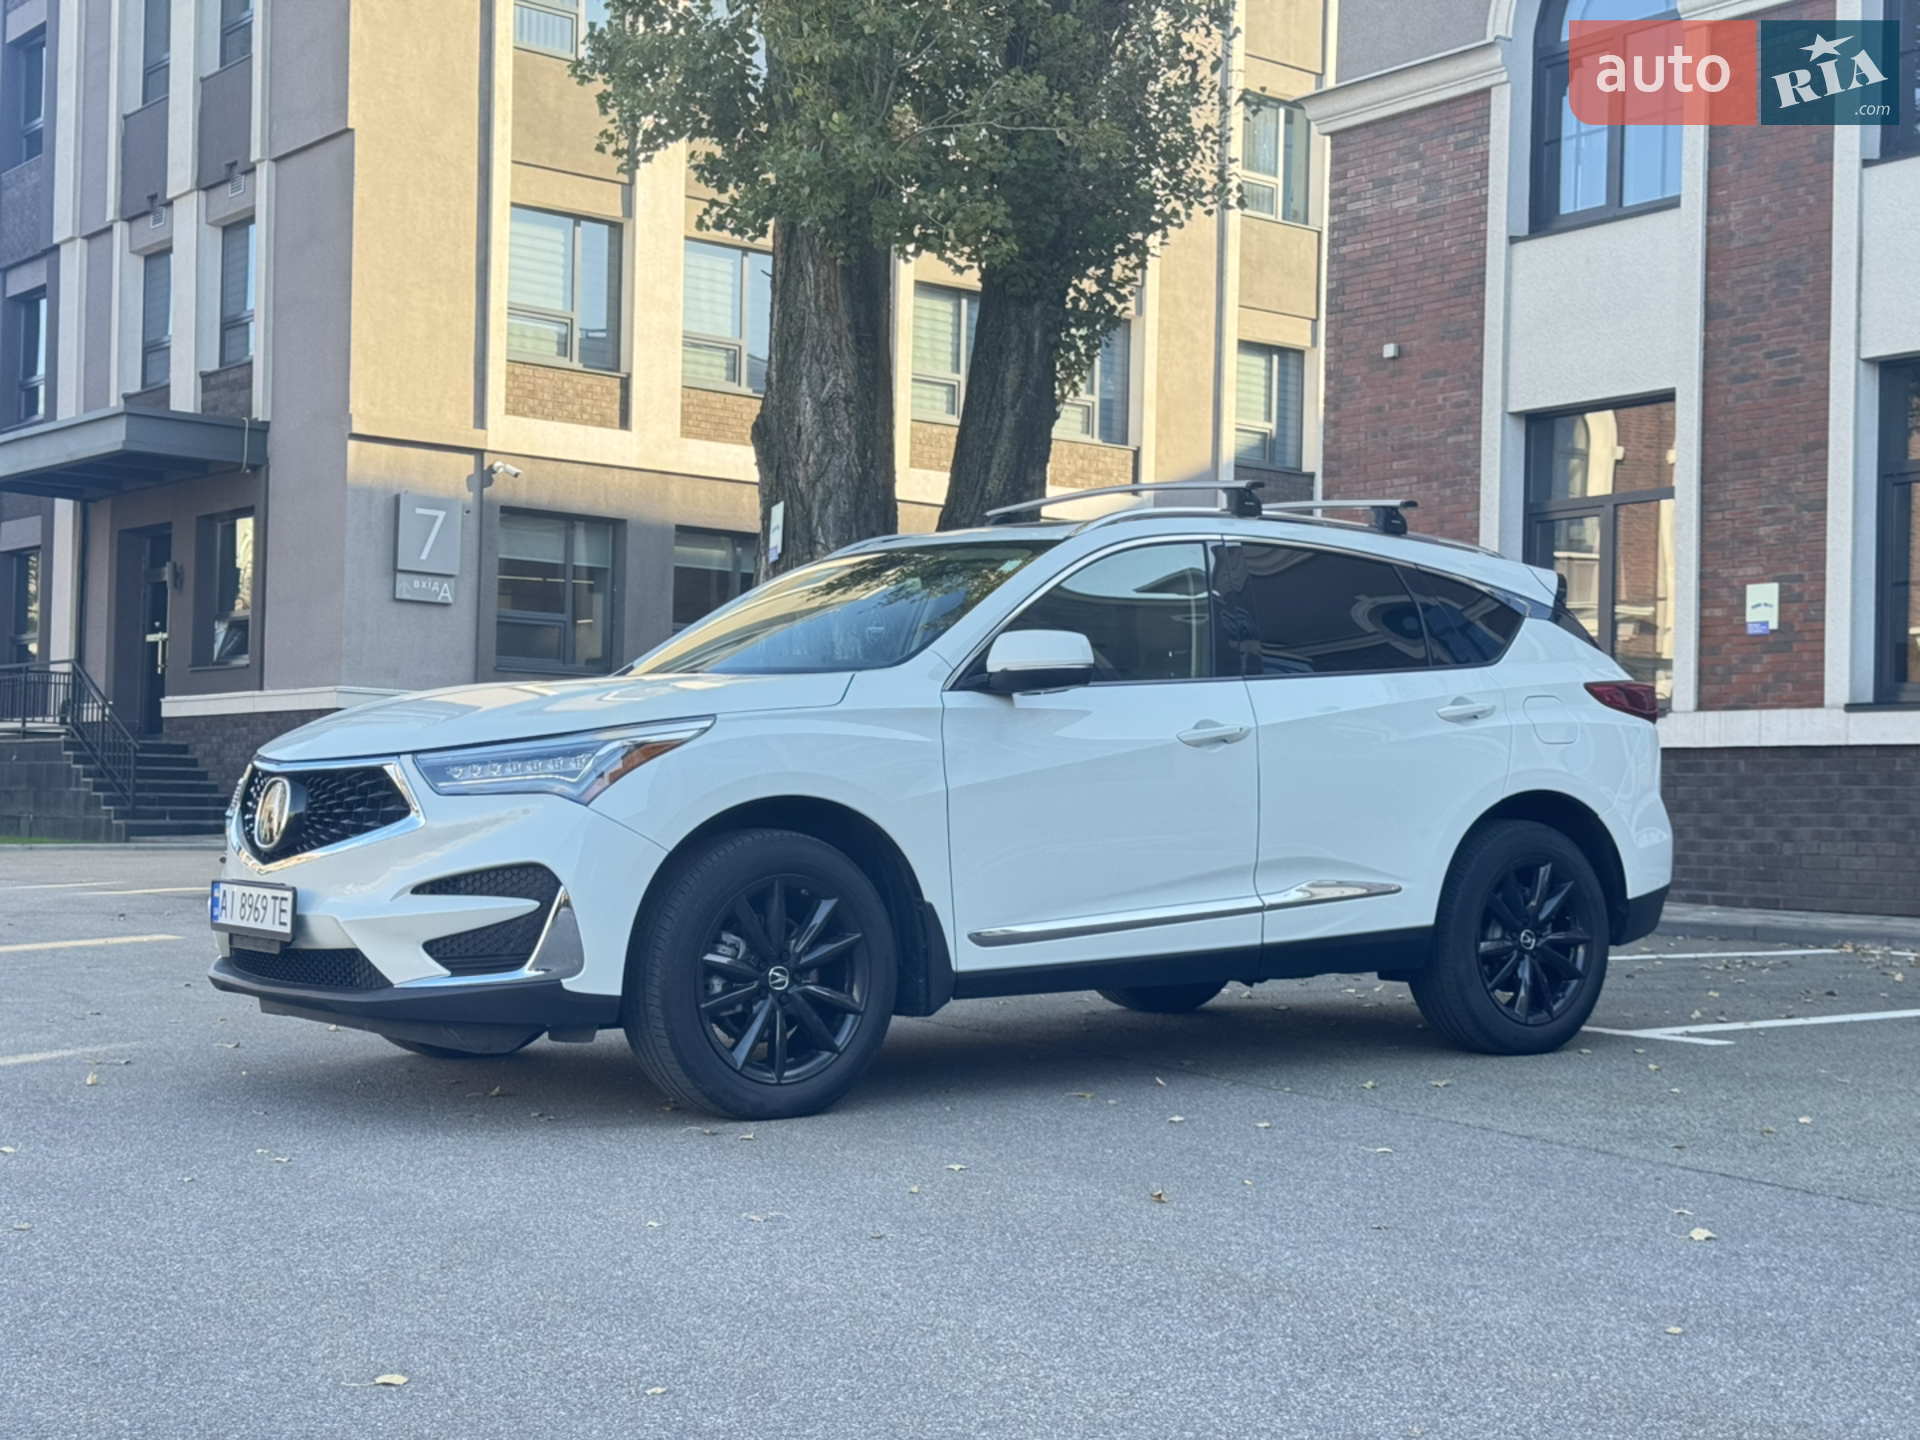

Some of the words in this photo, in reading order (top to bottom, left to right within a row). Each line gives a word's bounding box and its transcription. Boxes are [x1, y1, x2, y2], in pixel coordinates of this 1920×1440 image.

[415, 507, 447, 560] 7
[240, 892, 268, 923] 8969
[271, 895, 288, 926] TE
